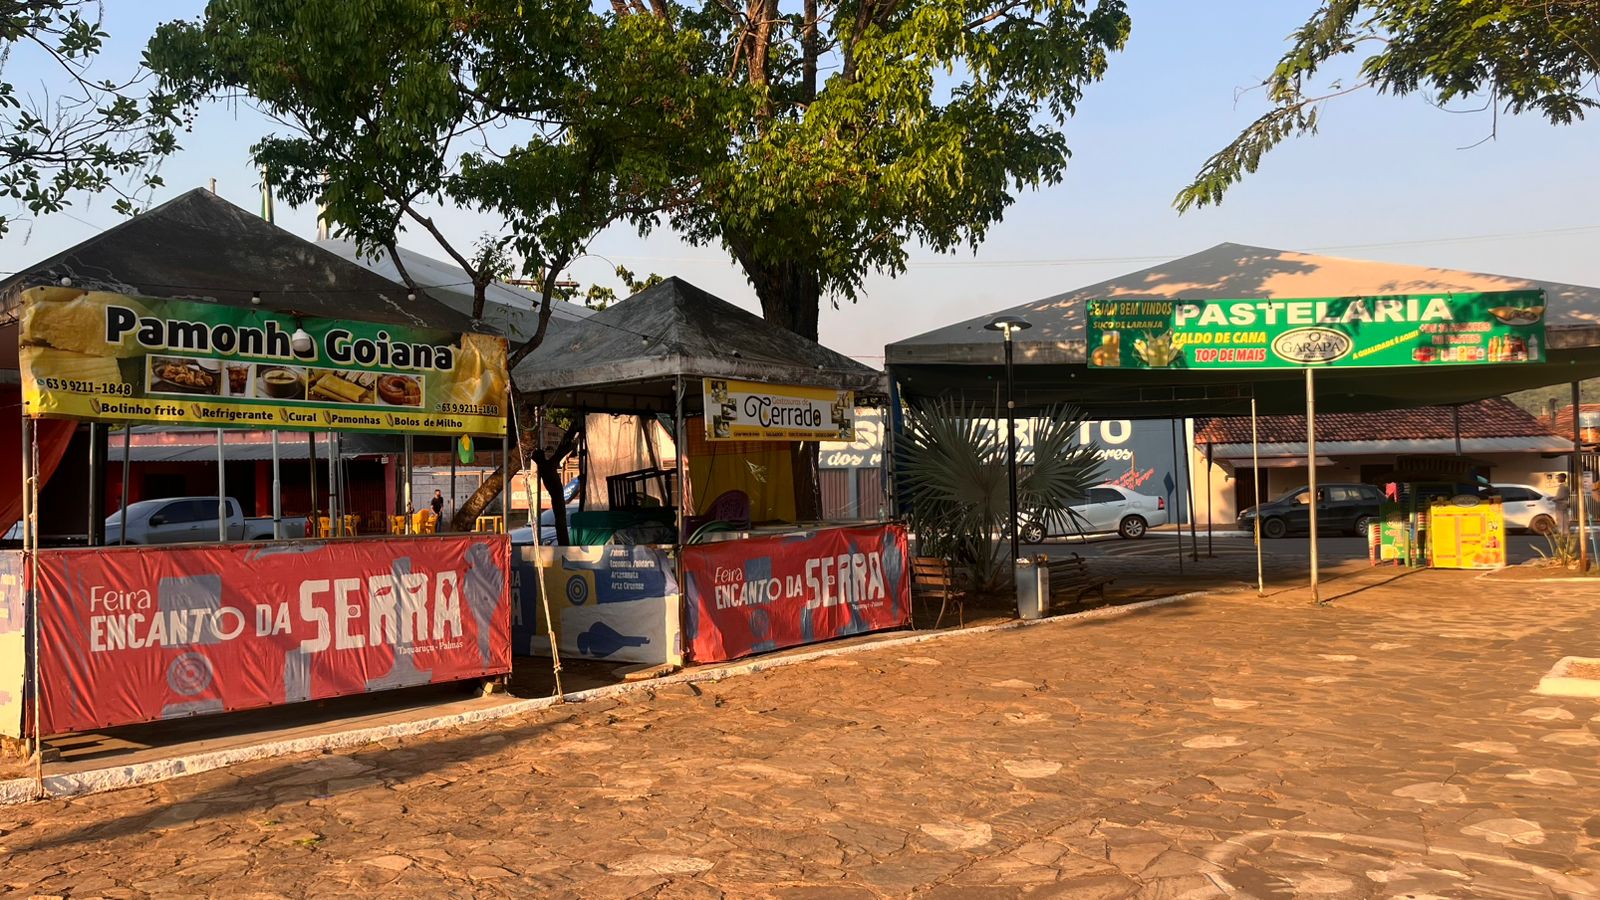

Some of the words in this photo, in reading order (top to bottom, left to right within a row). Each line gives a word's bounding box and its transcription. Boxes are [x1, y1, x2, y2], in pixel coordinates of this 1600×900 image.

[1120, 303, 1139, 315] BEM
[1142, 302, 1172, 315] VINDOS
[1175, 298, 1453, 326] PASTELARIA
[1093, 321, 1114, 329] SUCO
[1116, 321, 1125, 329] DE
[1127, 321, 1163, 329] LARANJA
[1172, 332, 1212, 344] CALDO
[1215, 331, 1230, 344] DE
[1233, 331, 1266, 344] CANA
[325, 328, 455, 372] Goiana
[1281, 342, 1341, 353] GARAPA
[1358, 339, 1395, 357] QUALIDADE
[1195, 349, 1217, 362] TOP
[1220, 349, 1234, 361] DE
[1237, 348, 1266, 361] MAIS
[46, 378, 59, 391] 63
[61, 381, 68, 391] 9
[69, 382, 132, 395] 9211-1848
[101, 403, 151, 416] Bolinho
[155, 405, 185, 417] frito
[202, 407, 273, 421] Refrigerante
[442, 403, 450, 412] 63
[289, 411, 317, 422] Cural
[332, 413, 381, 425] Pamonhas
[394, 415, 420, 427] Bolos
[424, 417, 434, 427] de
[436, 417, 462, 428] Milho
[828, 452, 864, 465] dos
[715, 566, 742, 584] Feira
[715, 577, 781, 610] ENCANTO
[786, 575, 803, 599] DA
[806, 552, 885, 610] SERRA
[90, 586, 150, 612] Feira
[90, 607, 245, 652] ENCANTO
[256, 602, 291, 637] DA
[300, 570, 462, 654] SERRA
[398, 645, 434, 655] Taquaruçu
[439, 641, 463, 650] Palmas
